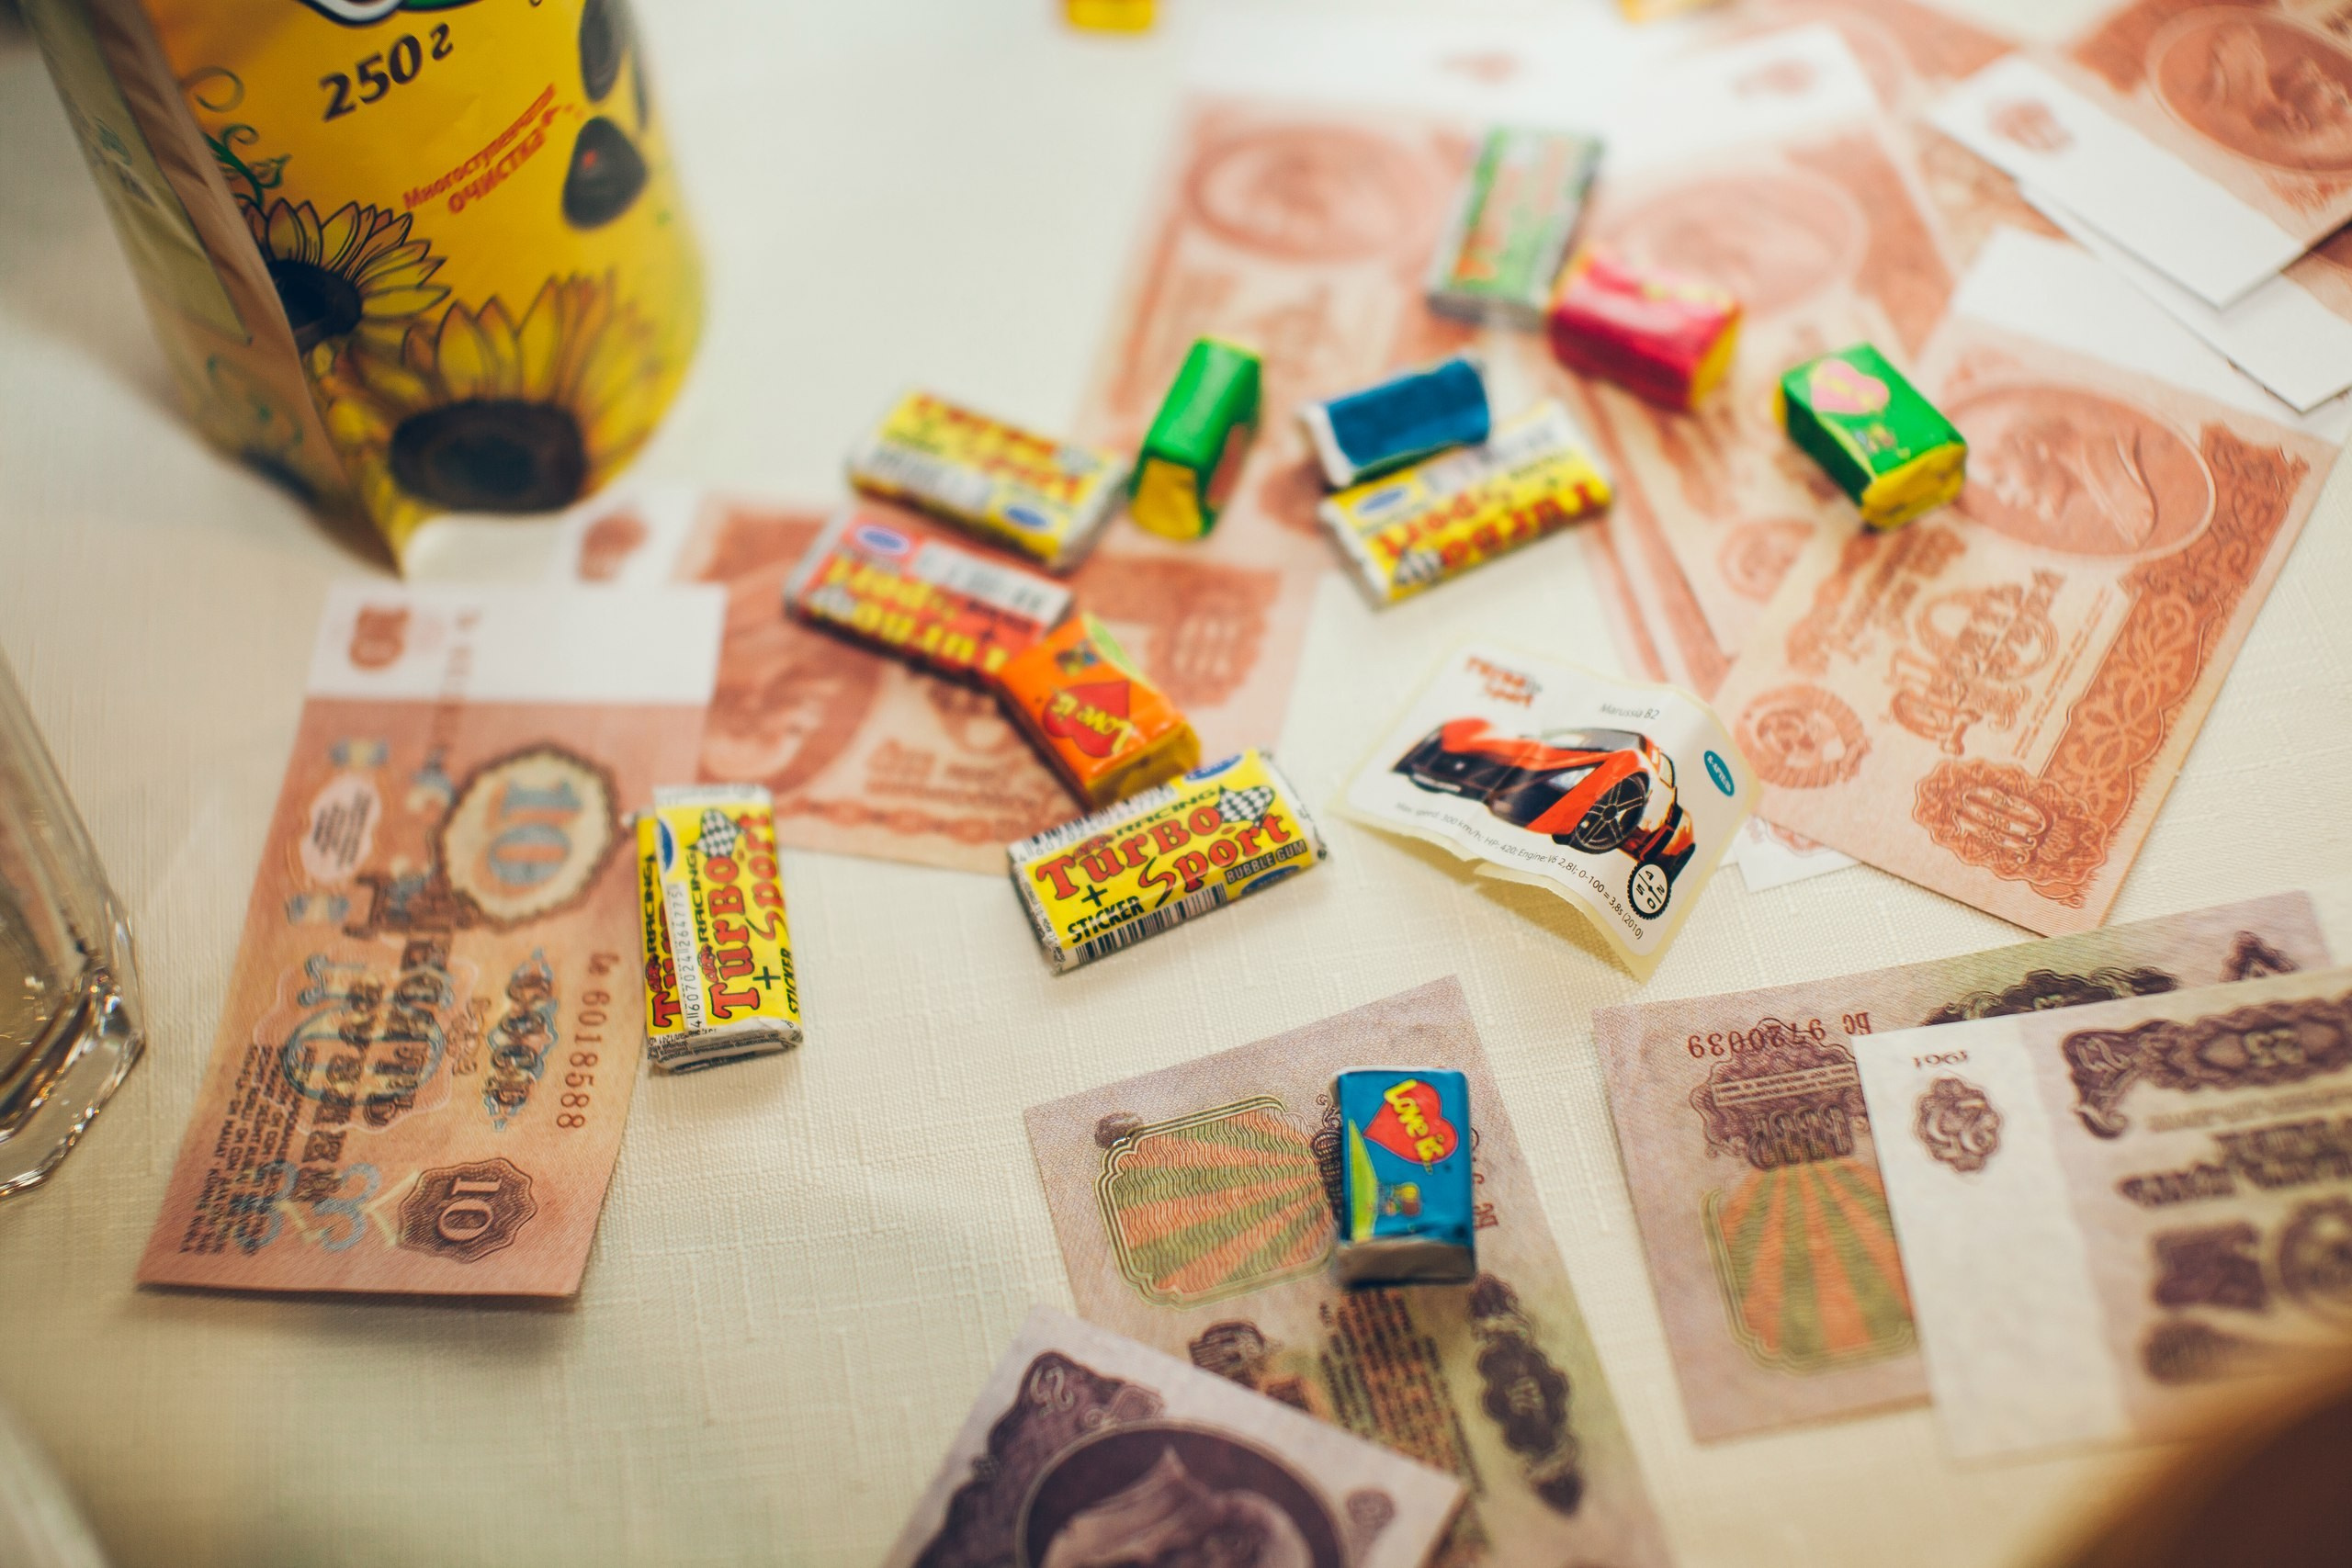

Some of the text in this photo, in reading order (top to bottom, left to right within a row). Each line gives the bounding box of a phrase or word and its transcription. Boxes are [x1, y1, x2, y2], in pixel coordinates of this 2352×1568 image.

[318, 34, 423, 123] 250
[1600, 703, 1660, 720] Marussia B2
[485, 774, 584, 889] 10
[1116, 791, 1217, 837] RACING
[1226, 852, 1276, 884] BUBBLE
[1276, 840, 1307, 863] GUM
[1441, 813, 1458, 826] 300
[1547, 854, 1558, 864] V6
[1578, 868, 1606, 894] 0-100
[1609, 897, 1624, 916] 3,8s
[1622, 912, 1645, 941] (2010)
[1067, 896, 1146, 943] STICKER
[780, 947, 800, 1017] STICKER
[556, 990, 611, 1130] 6018588
[436, 1176, 503, 1242] 10
